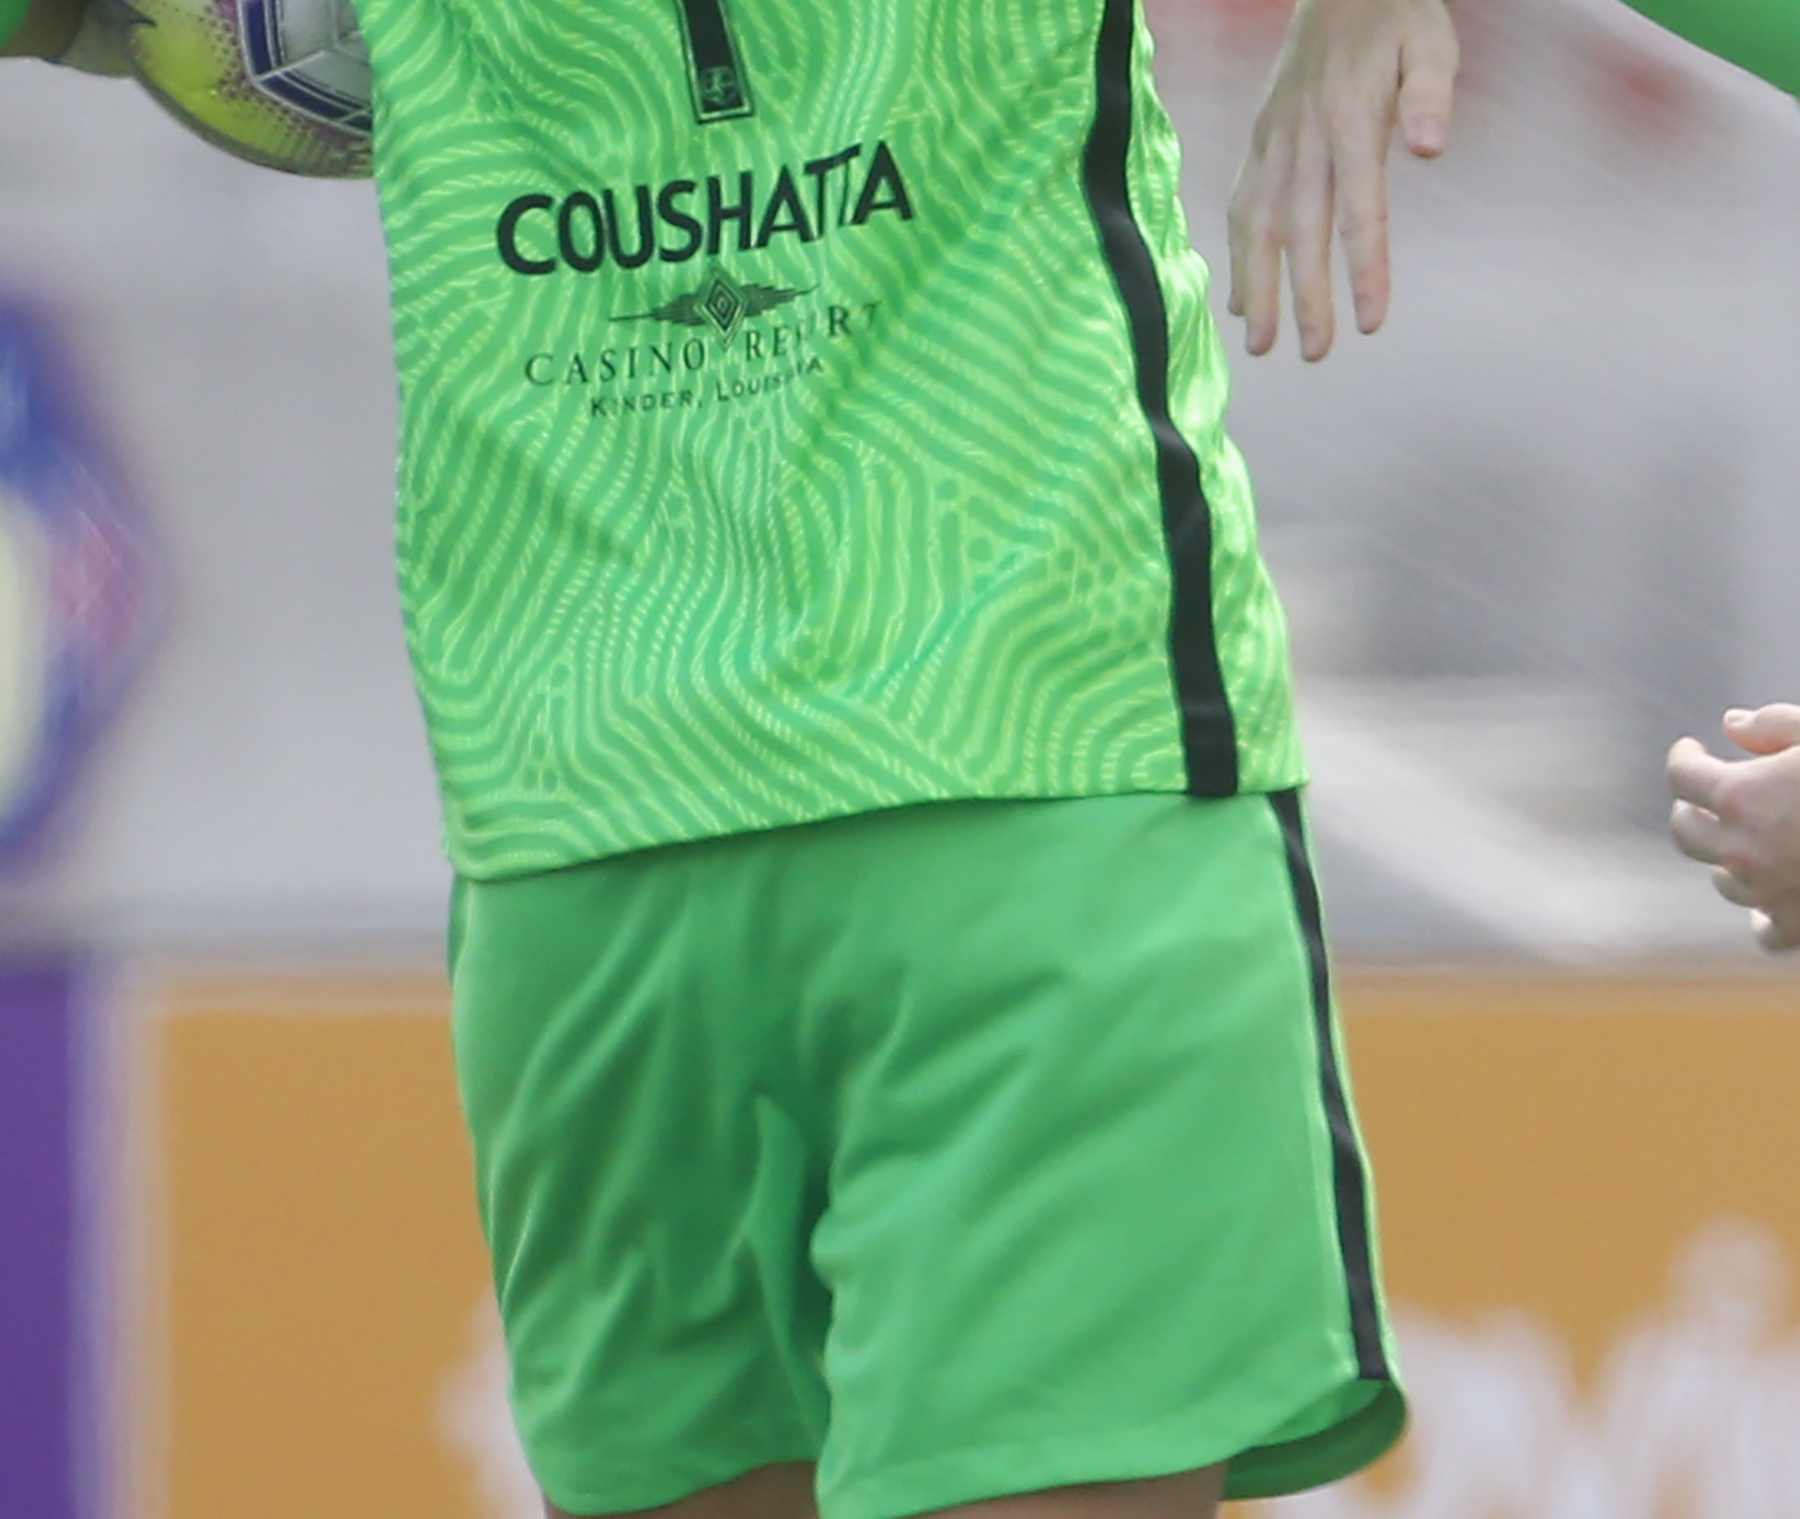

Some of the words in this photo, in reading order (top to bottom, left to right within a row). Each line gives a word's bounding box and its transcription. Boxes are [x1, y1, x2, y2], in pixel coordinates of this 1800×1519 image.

[495, 138, 914, 276] COUSHATTA
[525, 337, 706, 387] CASINO
[745, 299, 883, 363] RERT
